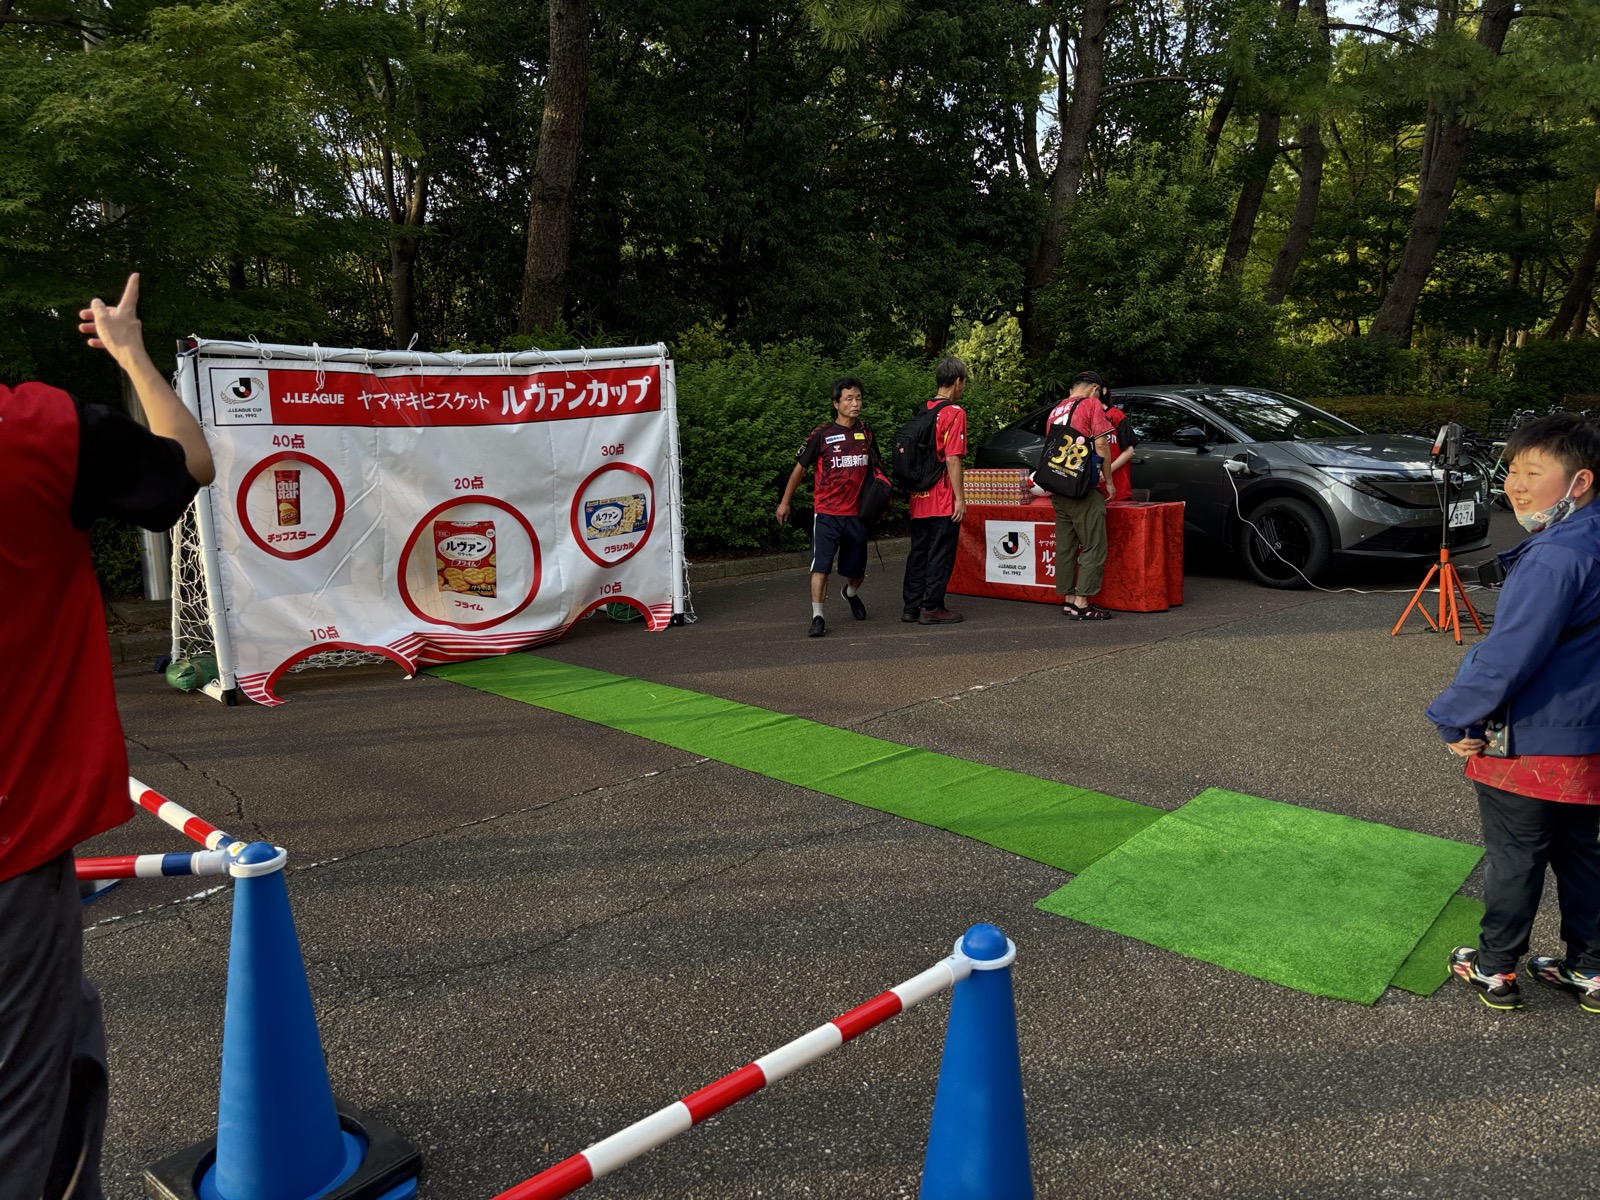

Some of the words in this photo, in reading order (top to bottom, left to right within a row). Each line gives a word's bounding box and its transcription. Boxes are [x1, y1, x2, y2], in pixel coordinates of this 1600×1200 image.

[282, 392, 345, 405] J.LEAGUE
[357, 390, 490, 411] ヤマザキビスケット
[501, 376, 652, 416] ルヴァンカップ
[272, 433, 305, 449] 40点
[601, 443, 625, 457] 30点
[277, 480, 299, 491] chip
[454, 476, 485, 490] 20点
[278, 489, 299, 500] star
[595, 510, 619, 523] ルヴァン
[267, 531, 316, 543] チップスター
[445, 541, 487, 553] ルヴァン
[604, 541, 635, 554] クラシカル
[599, 581, 623, 596] 10点
[454, 600, 484, 611] プライム
[310, 625, 340, 641] 10点
